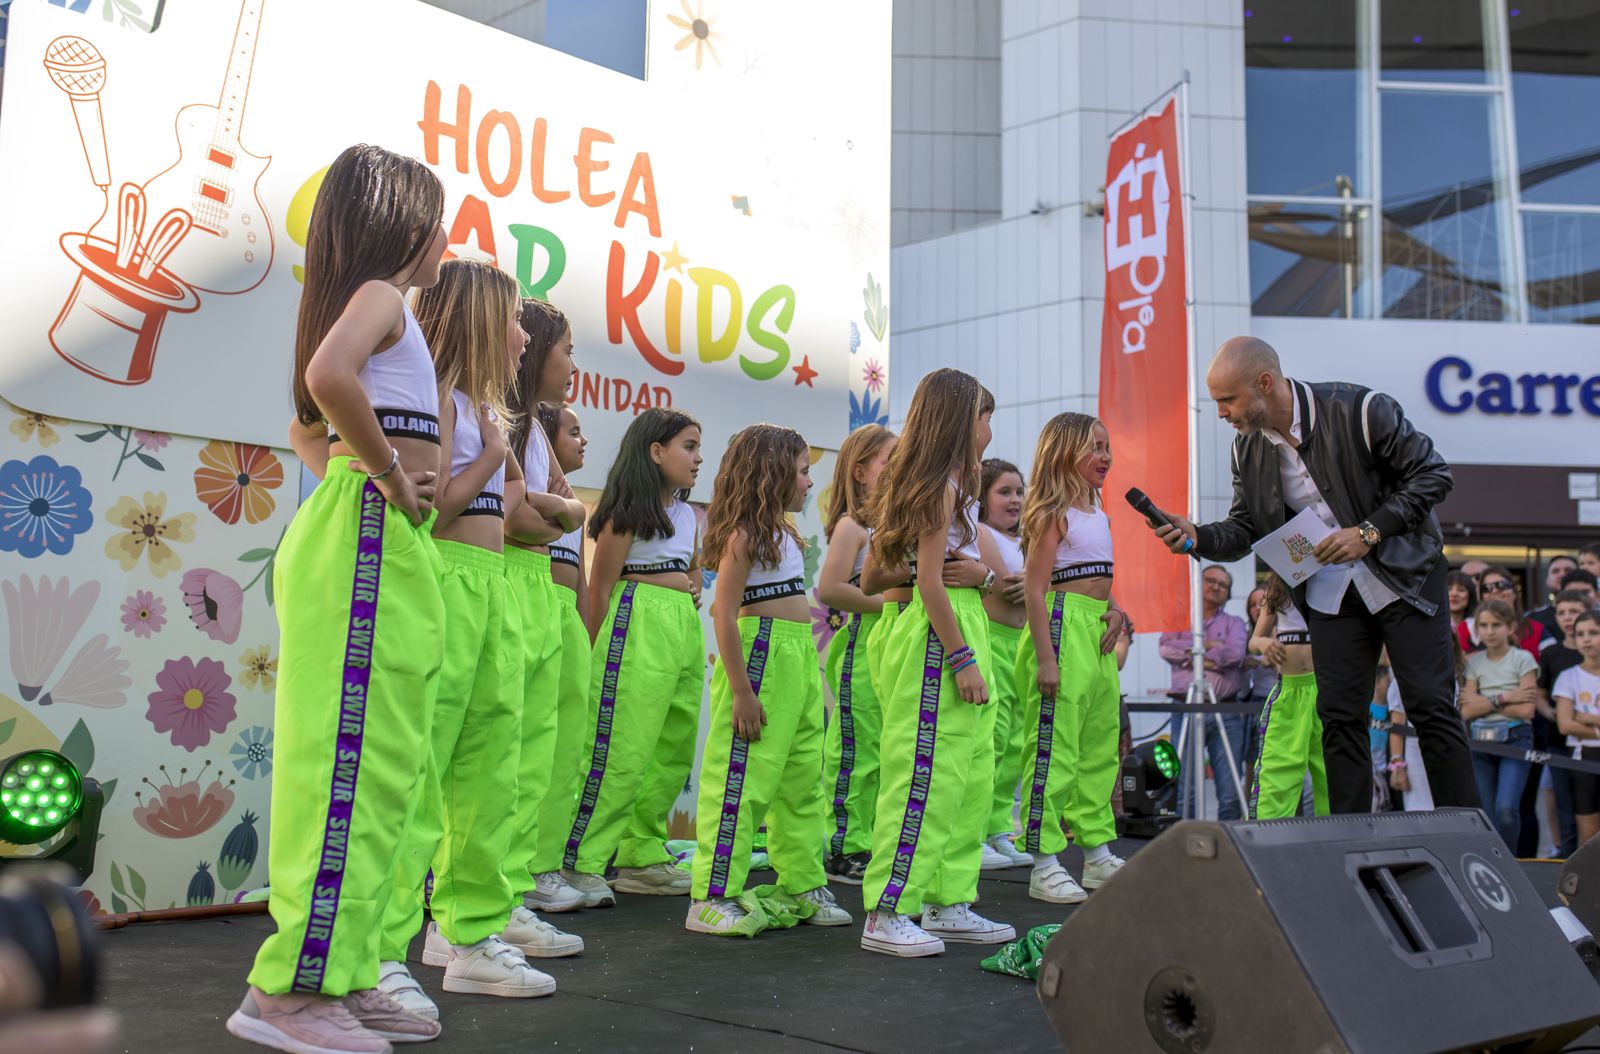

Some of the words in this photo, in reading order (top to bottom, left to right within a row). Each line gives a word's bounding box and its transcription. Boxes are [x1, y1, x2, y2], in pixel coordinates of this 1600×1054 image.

[417, 79, 662, 239] HOLEA
[361, 490, 382, 538] SWIR
[355, 552, 378, 603] SWIR
[615, 602, 630, 630] SWIR
[347, 616, 371, 668] SWIR
[608, 636, 624, 664] SWIR
[749, 649, 765, 682] SWIR
[602, 670, 617, 699] SWIR
[841, 681, 850, 707] SWIR
[922, 677, 939, 712] SWIR
[341, 682, 364, 736] SWIR
[598, 706, 613, 735] SWIR
[842, 713, 853, 738] SWIR
[917, 721, 934, 757] SWIR
[1040, 723, 1051, 751] SWIR
[593, 742, 607, 771] SWIR
[1034, 758, 1048, 785] SWIR
[334, 749, 357, 803] SWIR
[583, 777, 599, 807] SWIR
[725, 771, 742, 805] SWIR
[911, 765, 930, 801] SWIR
[1031, 793, 1042, 820] SWIR
[571, 812, 589, 841] SWIR
[719, 813, 736, 846] SWIR
[902, 808, 921, 845] SWIR
[322, 817, 348, 872] SWIR
[712, 854, 728, 887] SWIR
[890, 852, 910, 887] SWIR
[309, 886, 335, 941] SWIR
